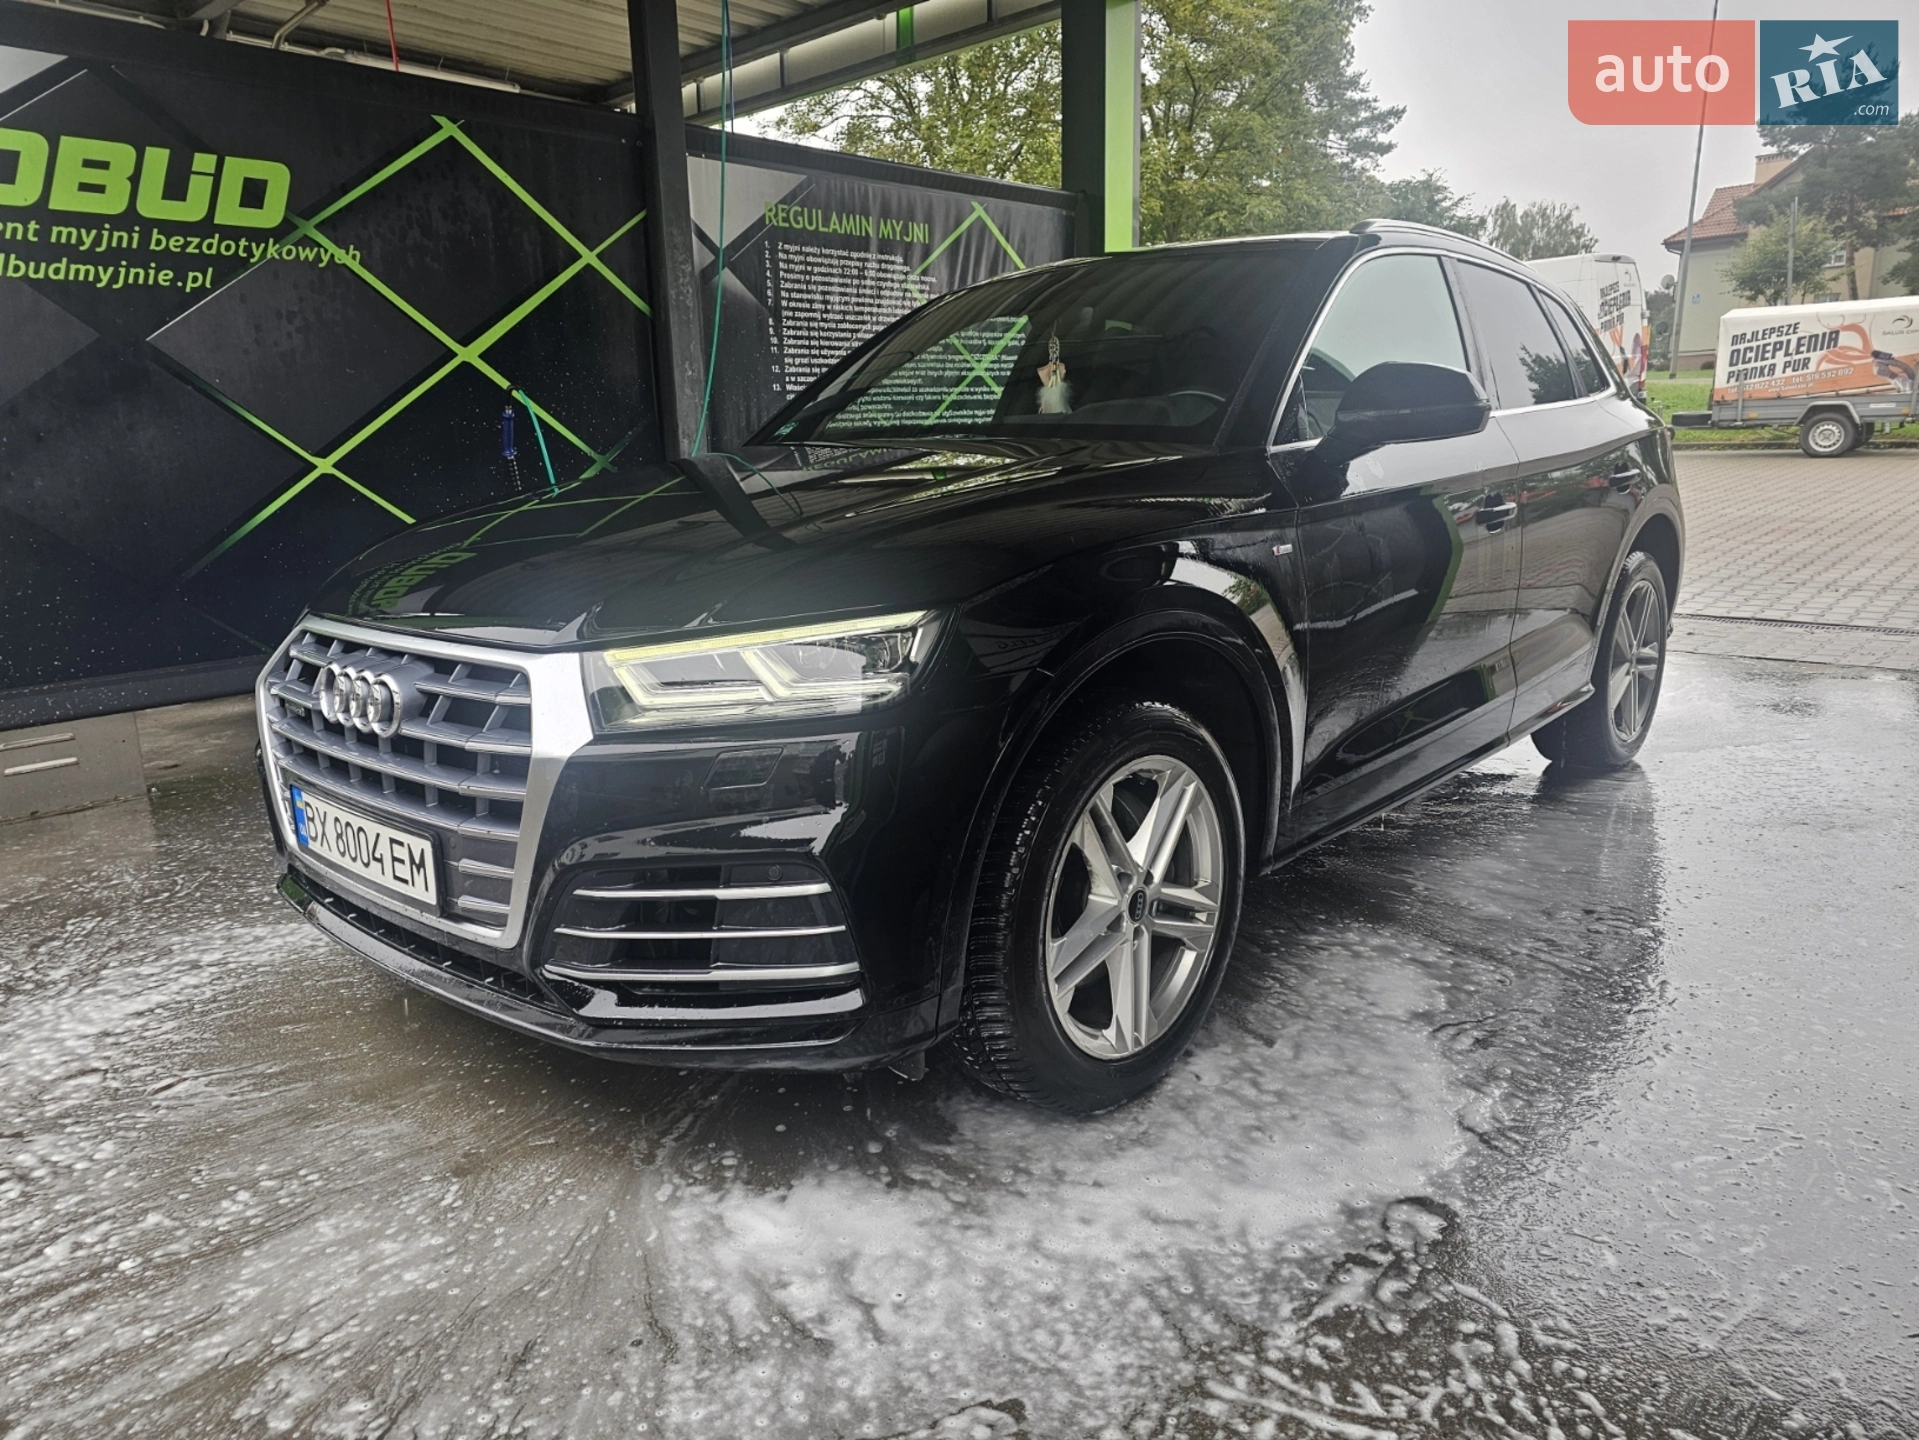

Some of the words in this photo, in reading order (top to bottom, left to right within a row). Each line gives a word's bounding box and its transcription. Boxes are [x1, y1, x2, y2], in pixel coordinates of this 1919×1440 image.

[764, 201, 874, 238] REGULAMIN
[879, 217, 930, 244] MYJNI
[0, 219, 41, 243] nt
[50, 223, 141, 252] myjni
[149, 228, 362, 268] bezdotykowych
[1728, 330, 1840, 368] OCIEPLENIA
[1731, 322, 1800, 346] NAJLEPSZE
[1726, 363, 1776, 384] PIANKA
[1782, 357, 1811, 374] PUR
[304, 800, 332, 852] BX
[334, 816, 385, 876] 8004
[389, 836, 429, 892] EM
